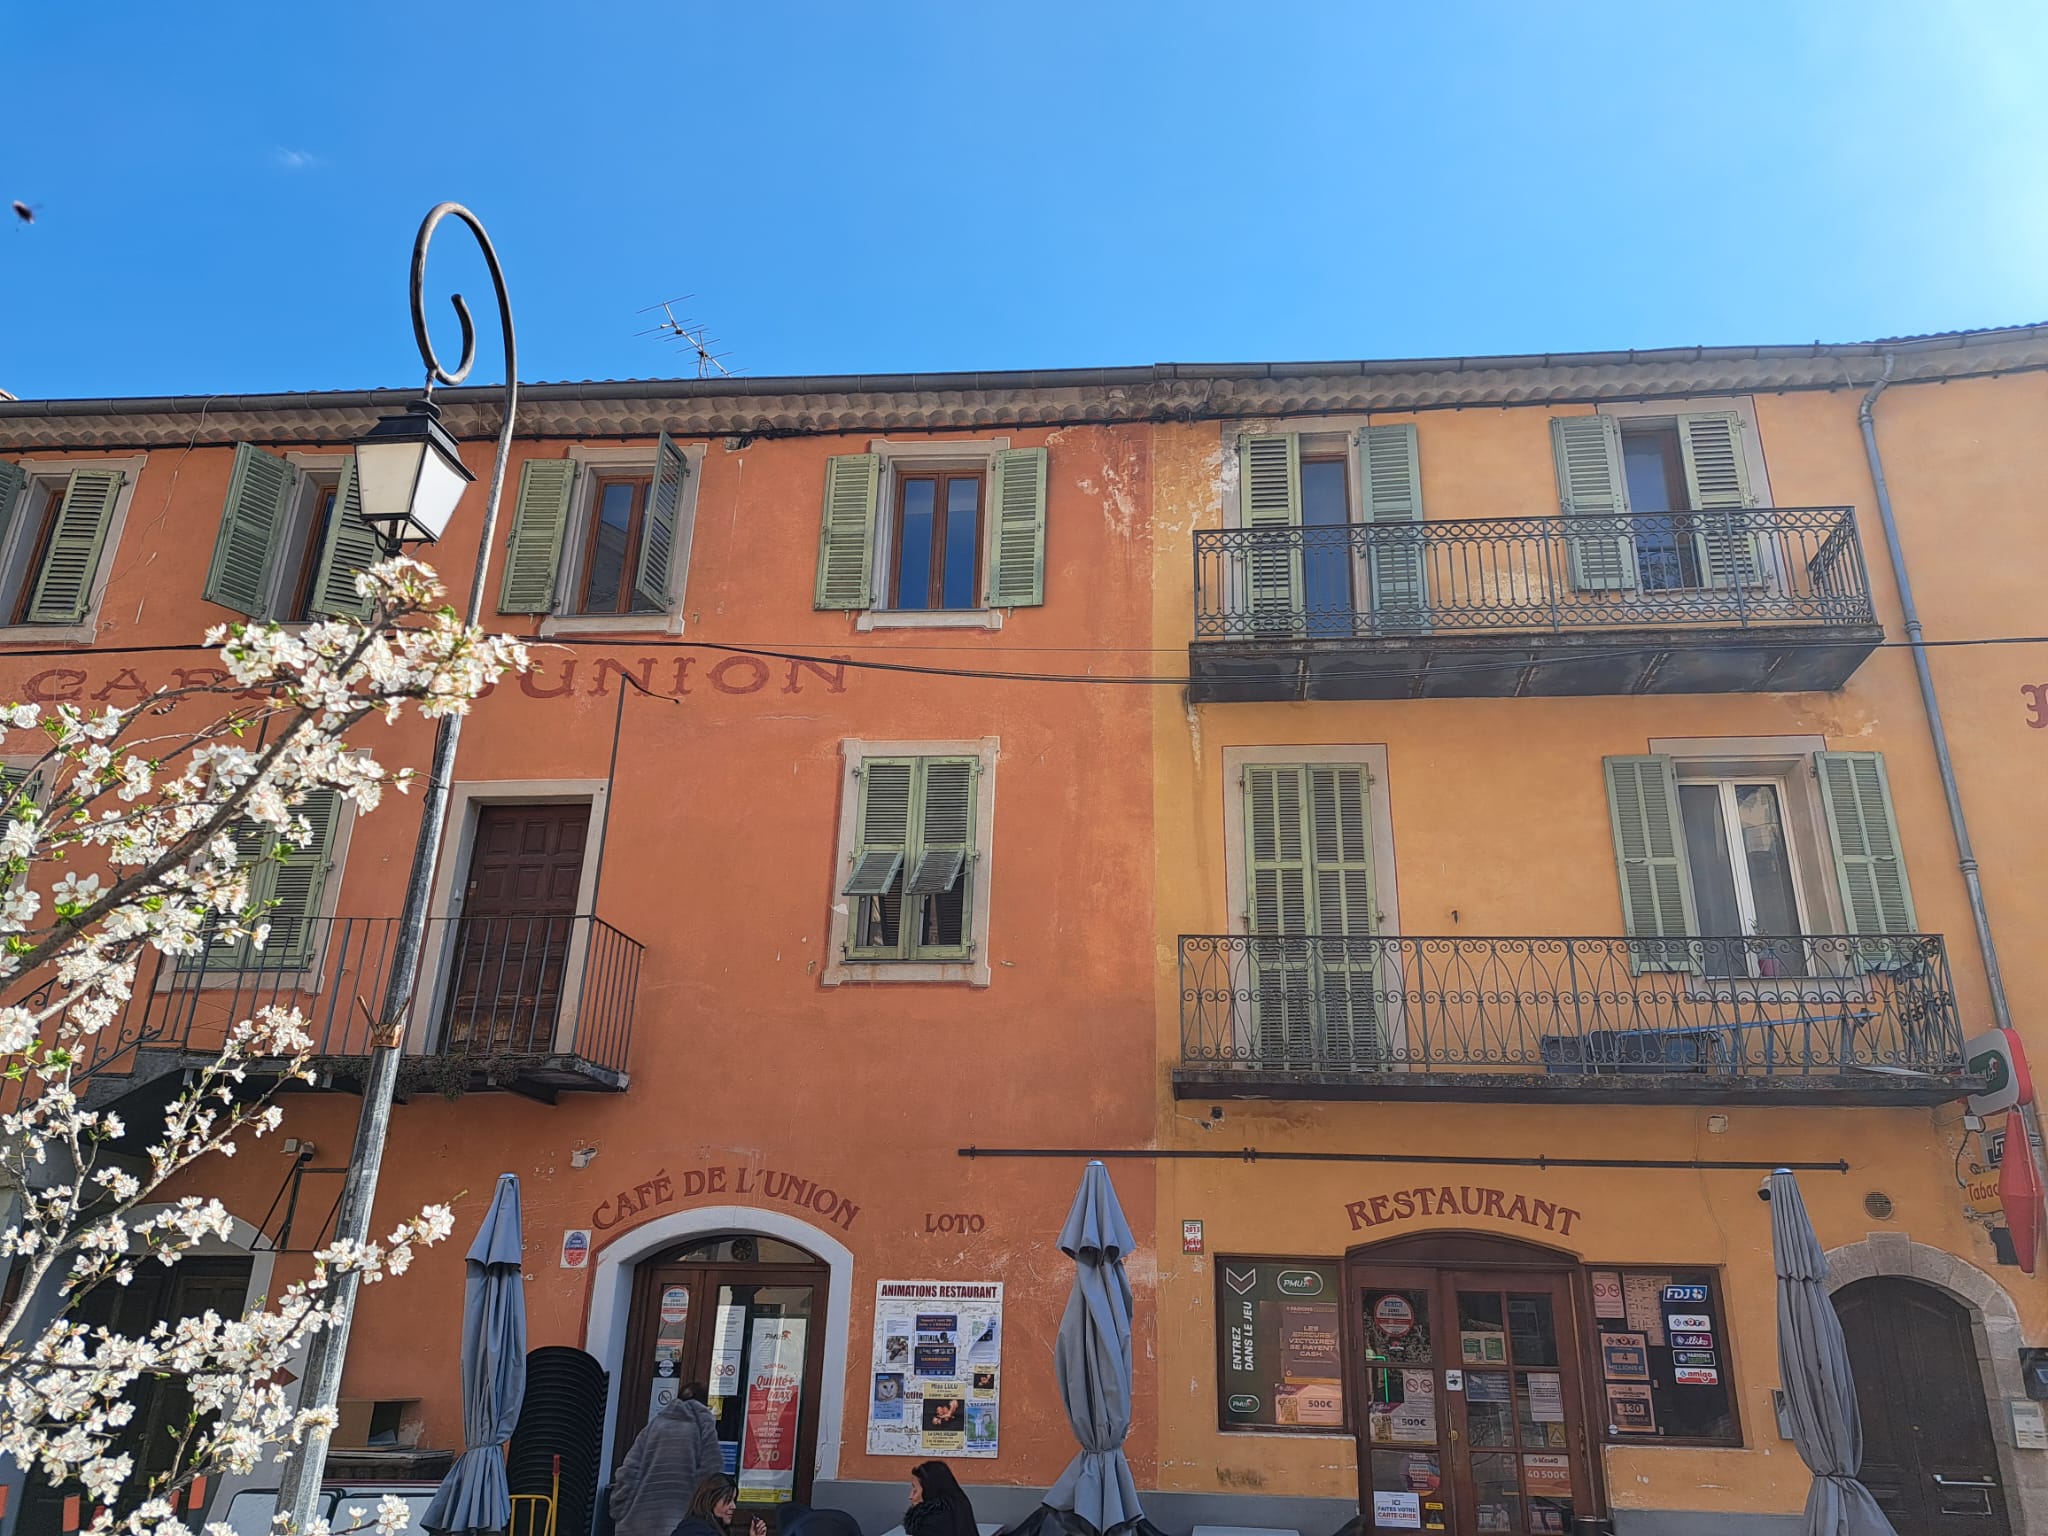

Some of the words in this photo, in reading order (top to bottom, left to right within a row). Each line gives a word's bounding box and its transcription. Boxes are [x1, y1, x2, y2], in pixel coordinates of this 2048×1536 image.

[592, 1168, 674, 1230] CAFÉ
[683, 1166, 727, 1197] DE
[735, 1168, 862, 1231] L'UNION
[1344, 1186, 1582, 1237] RESTAURANT
[925, 1213, 985, 1234] LOTO
[1283, 1279, 1305, 1288] PMU
[881, 1284, 938, 1298] ANIMATIONS
[939, 1286, 998, 1299] RESTAURANT
[1666, 1287, 1691, 1300] FDJ
[1243, 1301, 1253, 1322] JEU
[1243, 1323, 1253, 1336] LE
[1231, 1326, 1242, 1371] ENTREZ
[1244, 1339, 1254, 1371] DANS
[1687, 1369, 1713, 1383] amigo
[1308, 1400, 1333, 1408] 500€
[1622, 1404, 1641, 1413] 130
[1401, 1418, 1427, 1427] 500€
